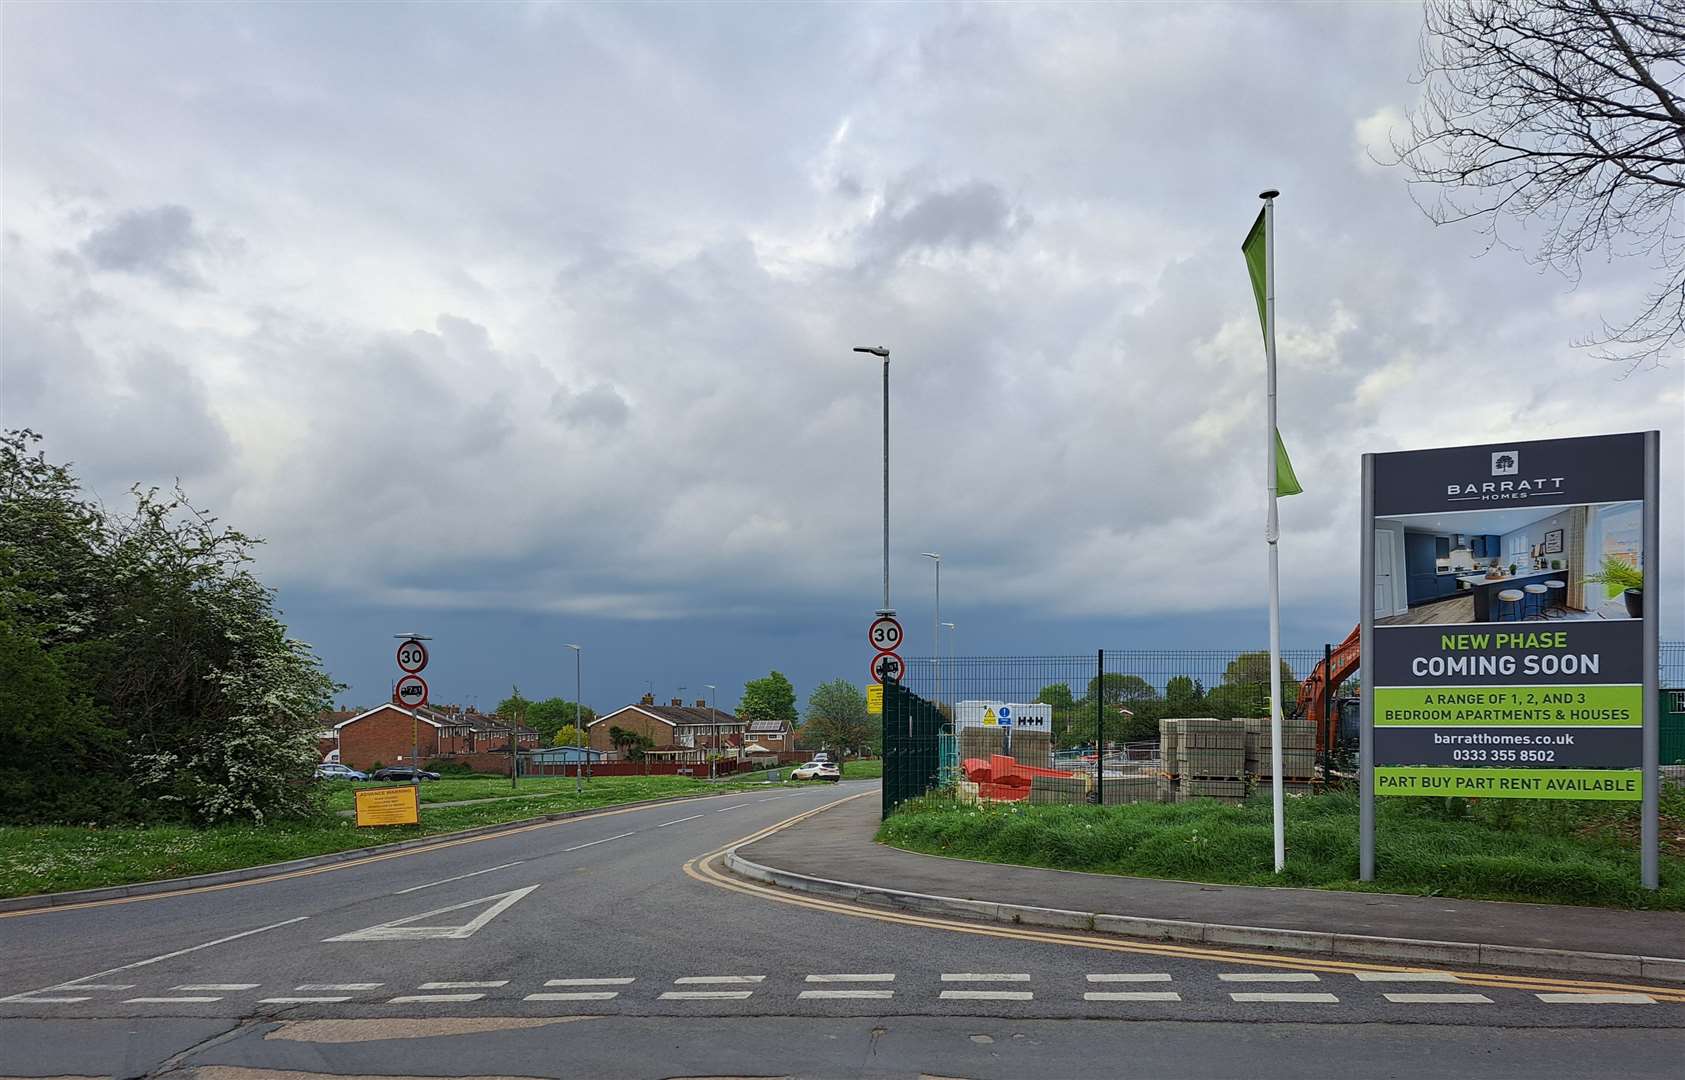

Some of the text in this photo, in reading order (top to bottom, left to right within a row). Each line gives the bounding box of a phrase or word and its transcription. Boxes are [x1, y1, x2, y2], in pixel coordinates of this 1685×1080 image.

[1447, 477, 1565, 495] BARRATT
[1481, 492, 1529, 501] HOMES
[874, 628, 898, 642] 30
[1441, 631, 1568, 650] NEW PHASE
[401, 650, 422, 664] 30
[1412, 653, 1600, 677] COMING SOON
[1424, 693, 1587, 707] A RANGE OF 1, 2, AND 3
[1385, 709, 1630, 721] BEDROOM APARTMENTS & HOUSES
[1434, 733, 1575, 746] barratthomes.co.uk
[1453, 749, 1555, 762] 0333 355 8502
[1378, 776, 1637, 792] PART BUY PART RENT AVAILABLE
